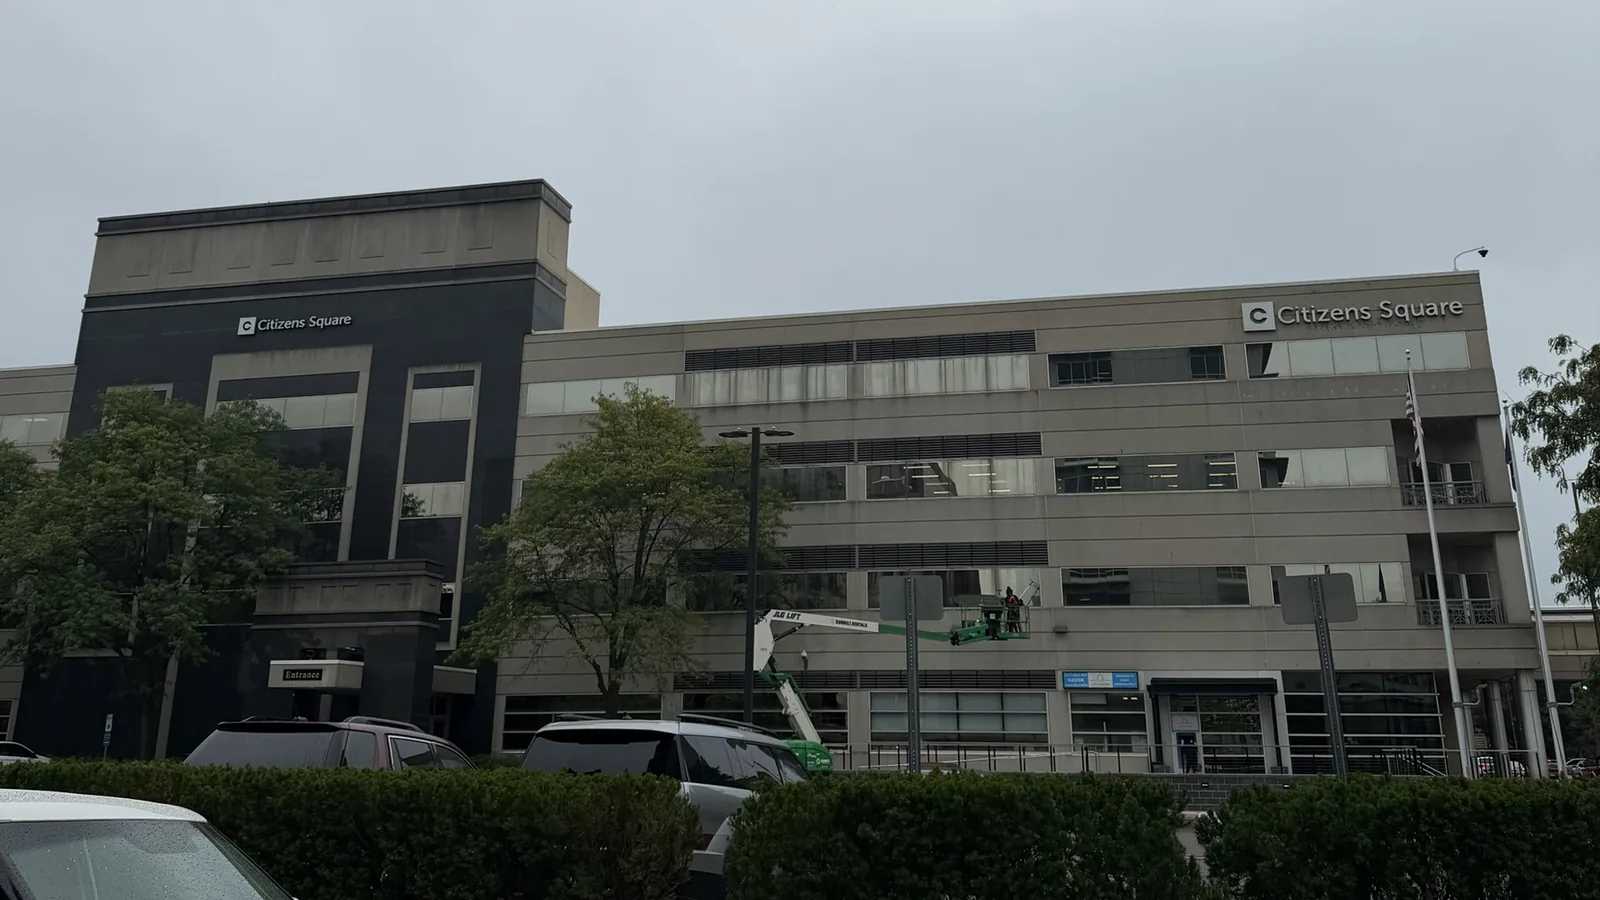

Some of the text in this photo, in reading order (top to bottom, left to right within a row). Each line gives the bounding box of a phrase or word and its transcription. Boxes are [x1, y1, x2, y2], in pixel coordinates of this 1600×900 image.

[1277, 304, 1371, 324] Citizens
[1379, 300, 1464, 323] Square
[257, 318, 306, 331] Citizens
[308, 315, 352, 328] Square
[773, 611, 801, 620] JLG LIFT
[285, 670, 320, 679] Entrance
